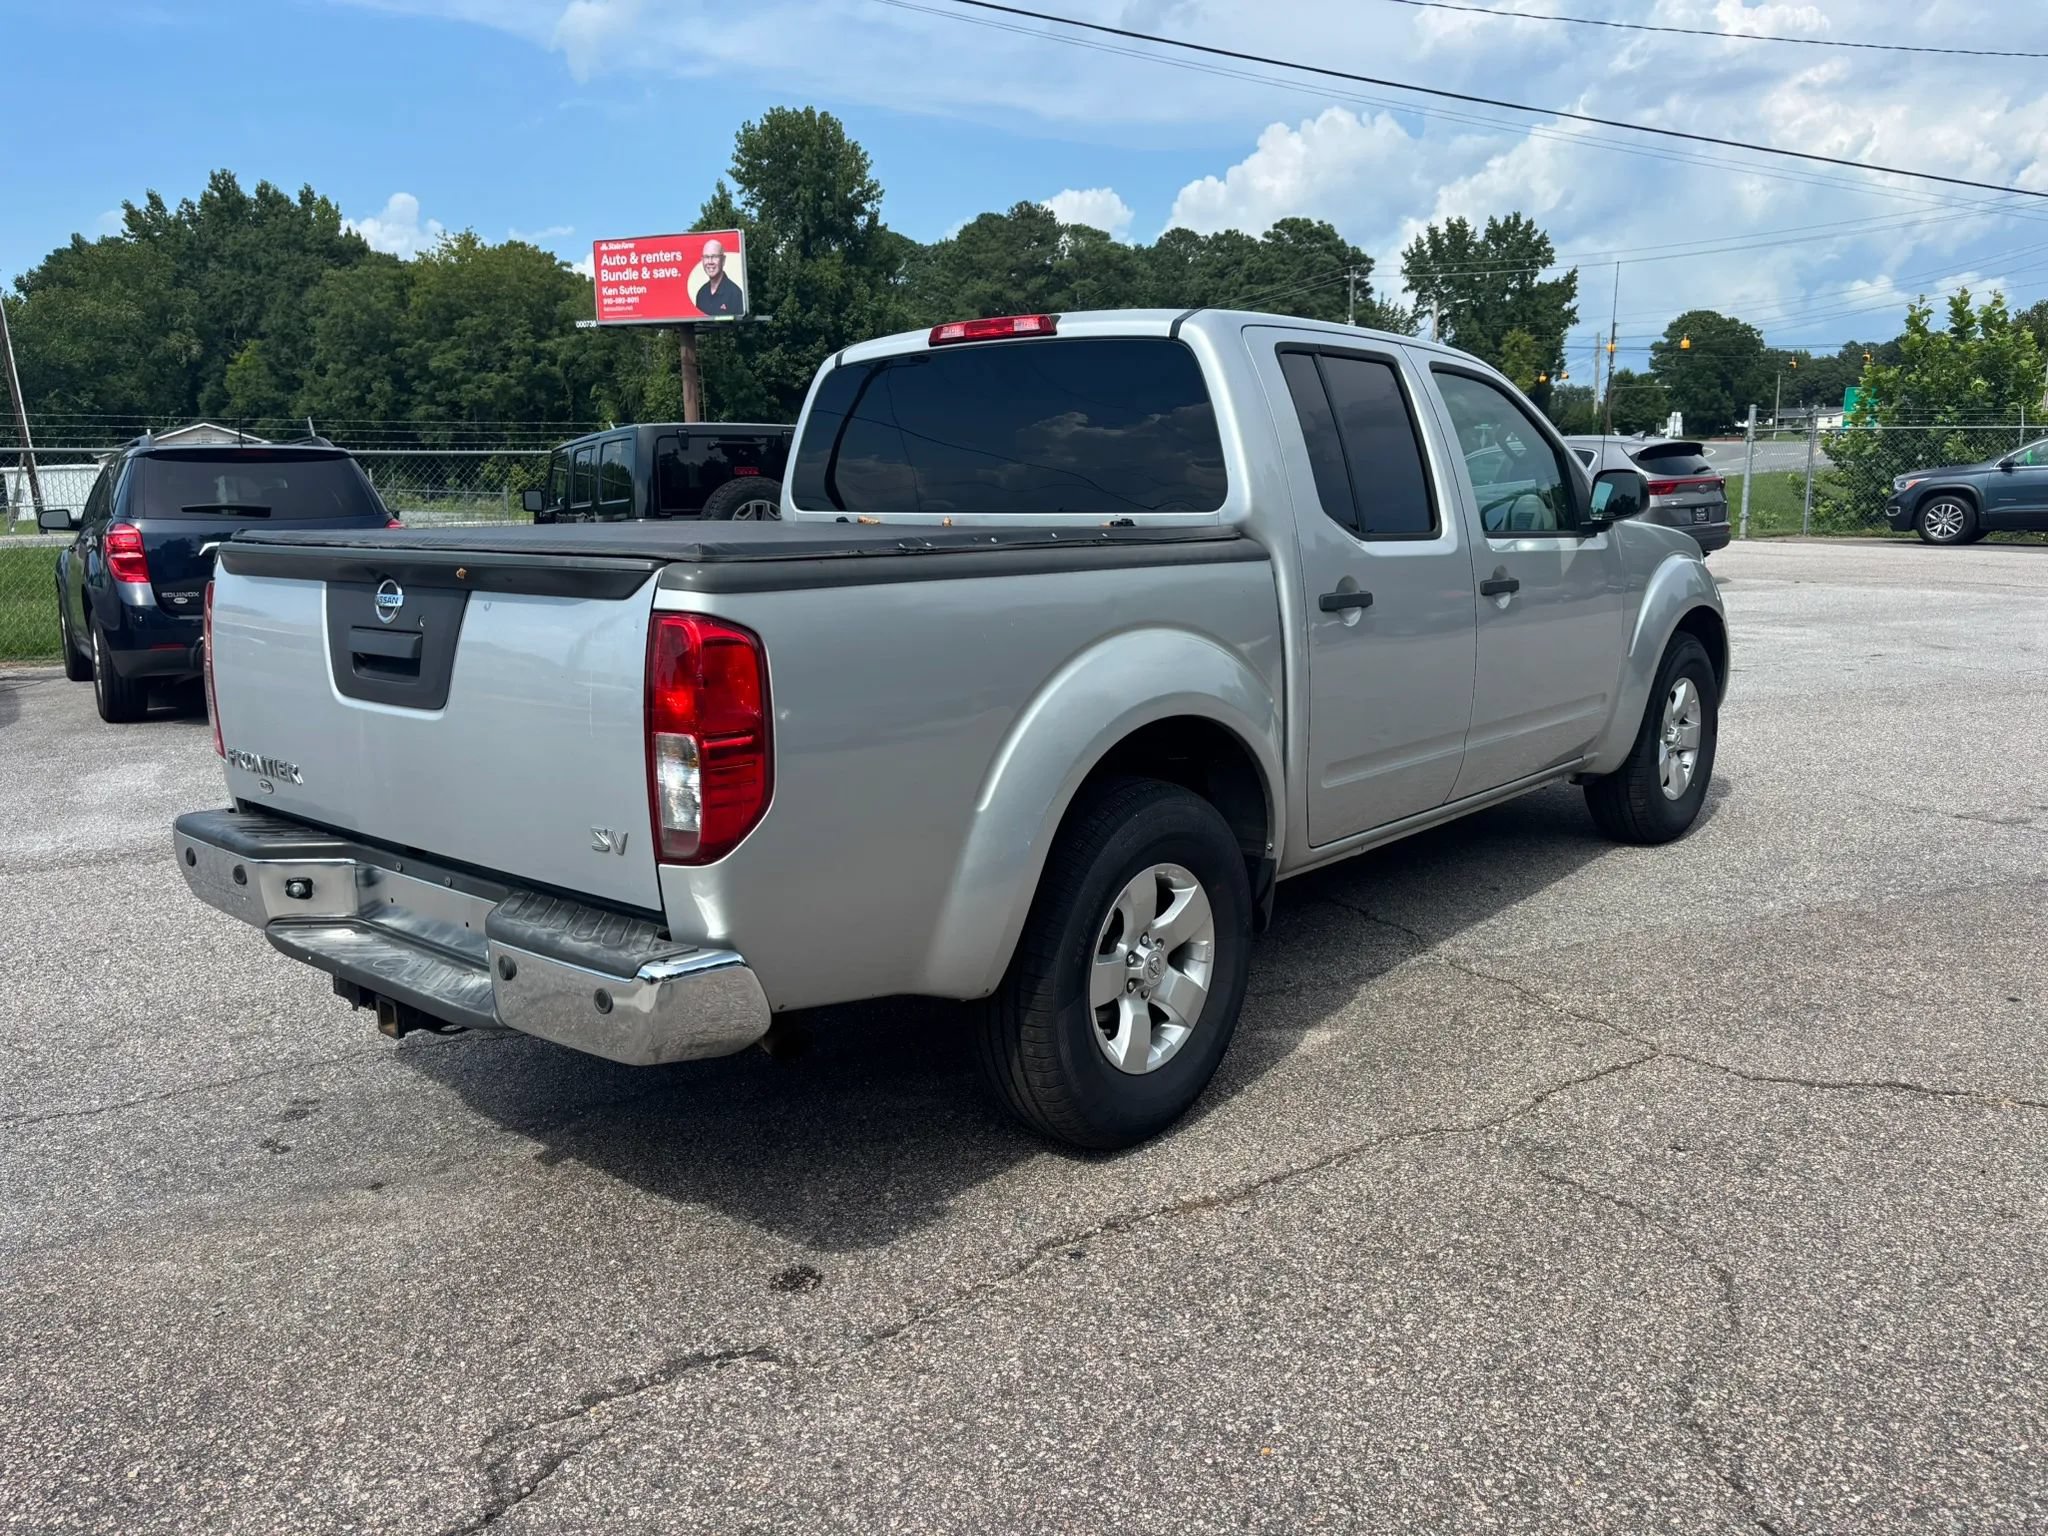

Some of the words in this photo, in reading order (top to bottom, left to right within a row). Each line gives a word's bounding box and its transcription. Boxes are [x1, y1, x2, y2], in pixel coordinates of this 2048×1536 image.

[601, 253, 627, 267] Auto
[629, 252, 639, 265] &
[641, 250, 682, 264] renters
[601, 267, 639, 282] Bundle
[641, 267, 650, 280] &
[653, 267, 681, 279] save.
[602, 286, 618, 296] Ken
[619, 285, 647, 295] Sutton
[227, 747, 304, 785] FRONTIER
[591, 825, 629, 856] SV
